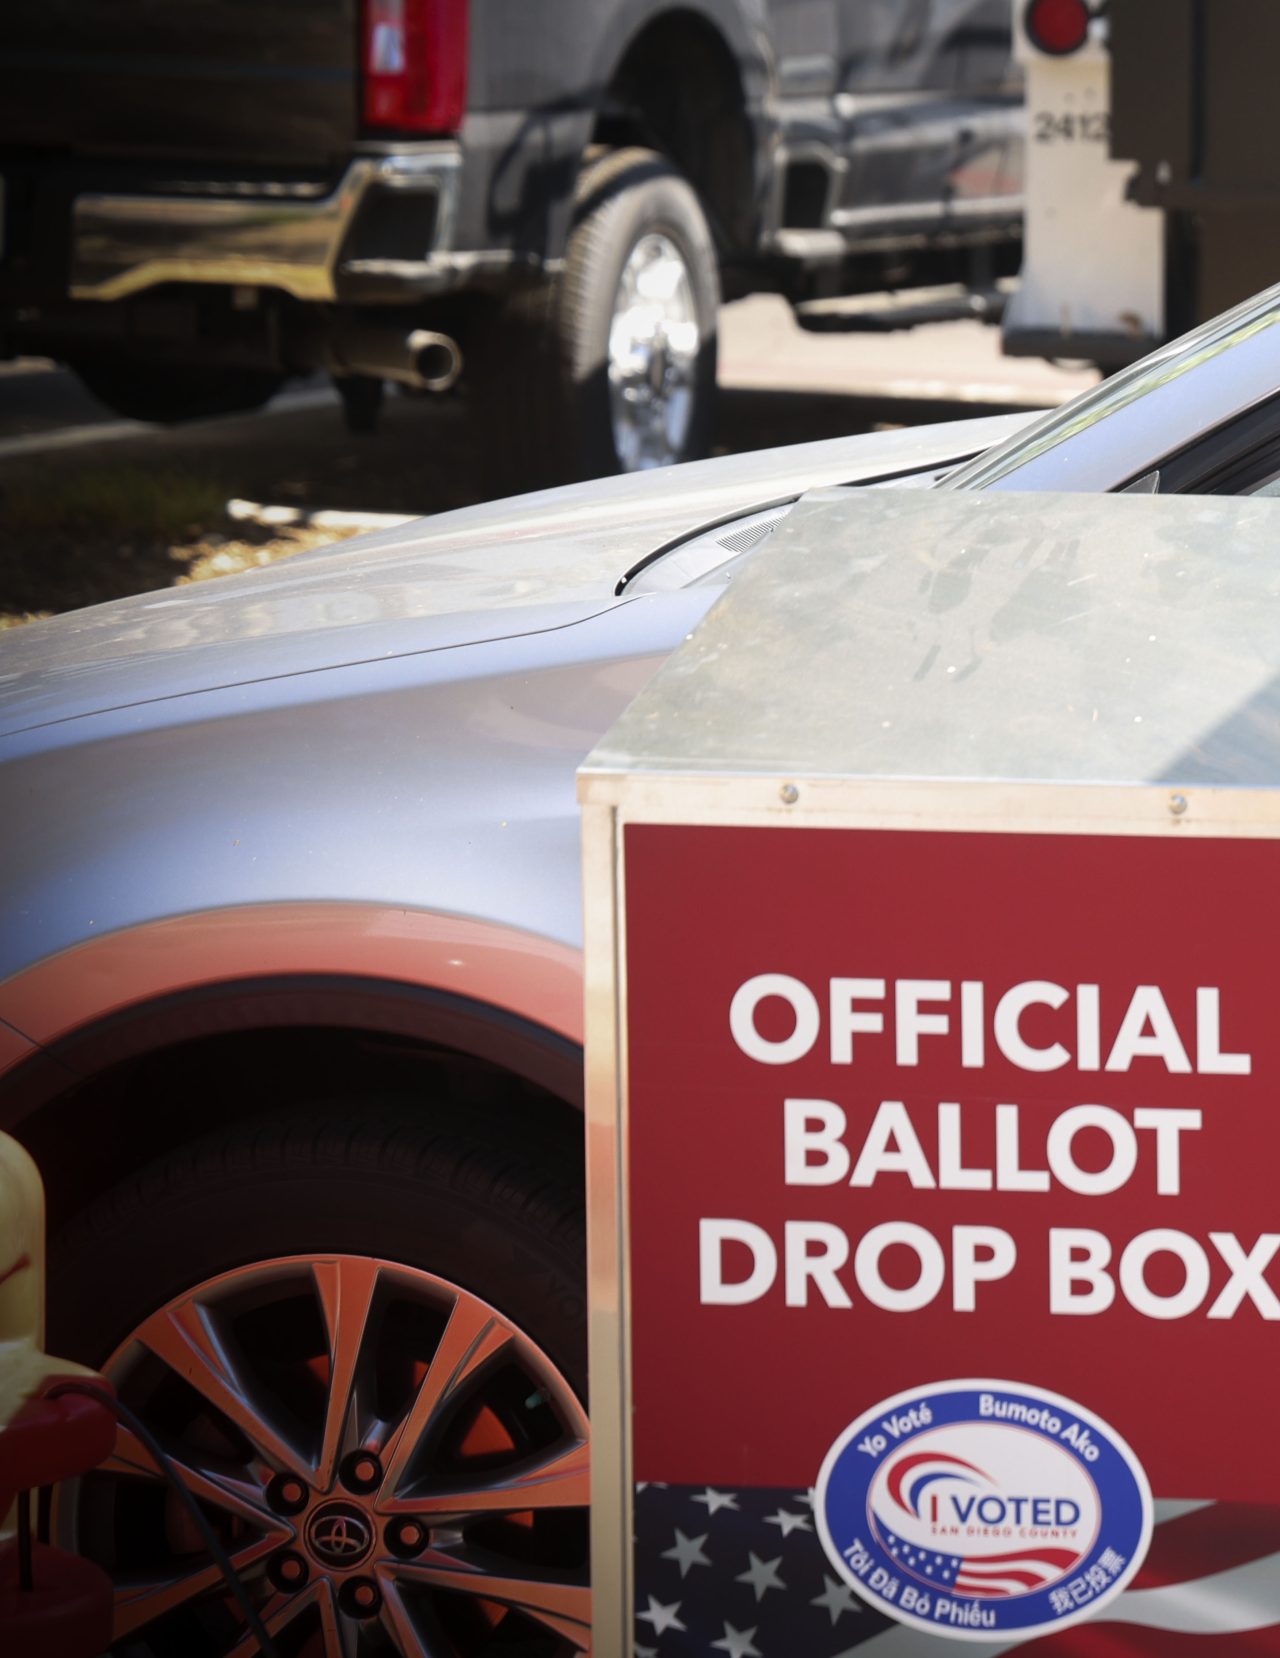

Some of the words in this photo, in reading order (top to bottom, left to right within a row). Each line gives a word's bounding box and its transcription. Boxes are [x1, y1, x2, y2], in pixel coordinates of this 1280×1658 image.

[730, 973, 1252, 1075] OFFICIAL
[784, 1098, 1202, 1196] BALLOT
[700, 1218, 1017, 1312] DROP
[857, 1434, 887, 1458] Yo
[881, 1402, 933, 1438] Voté
[979, 1394, 1062, 1434] Bumoto
[1060, 1423, 1100, 1462] Ako
[931, 1494, 938, 1523] I
[951, 1494, 1080, 1526] VOTED
[931, 1526, 959, 1536] SAN
[966, 1527, 1012, 1537] DIEGO
[1019, 1527, 1078, 1539] COUNTY
[843, 1538, 875, 1577] Tôi
[934, 1599, 996, 1627] Phiếu
[1048, 1546, 1126, 1616] 我已投票
